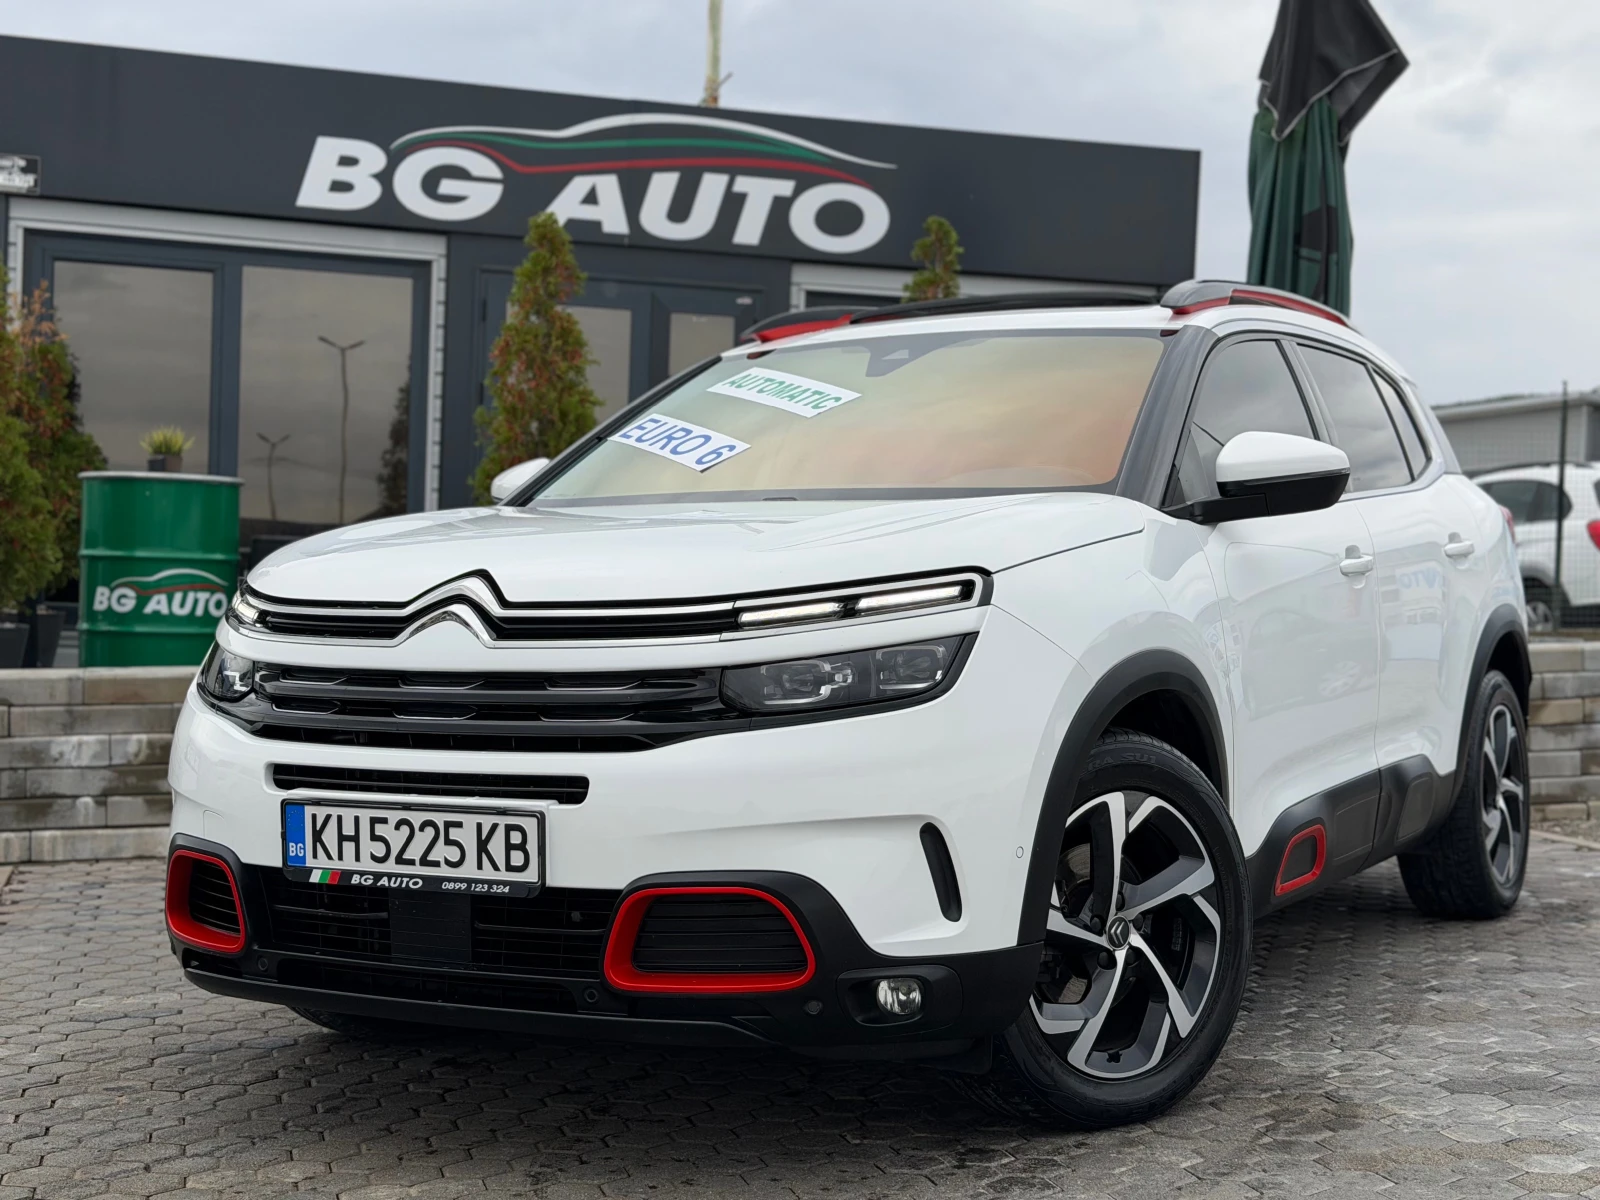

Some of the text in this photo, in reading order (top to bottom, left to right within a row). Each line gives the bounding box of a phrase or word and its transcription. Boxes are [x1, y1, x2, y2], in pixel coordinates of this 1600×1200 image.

[295, 135, 891, 254] BG AUTO
[722, 373, 843, 410] AUTOMATIC
[619, 417, 737, 466] EURO 6
[92, 585, 228, 618] BG AUTO
[289, 842, 305, 857] BG
[351, 874, 510, 893] BG AUTO 0899 123 324
